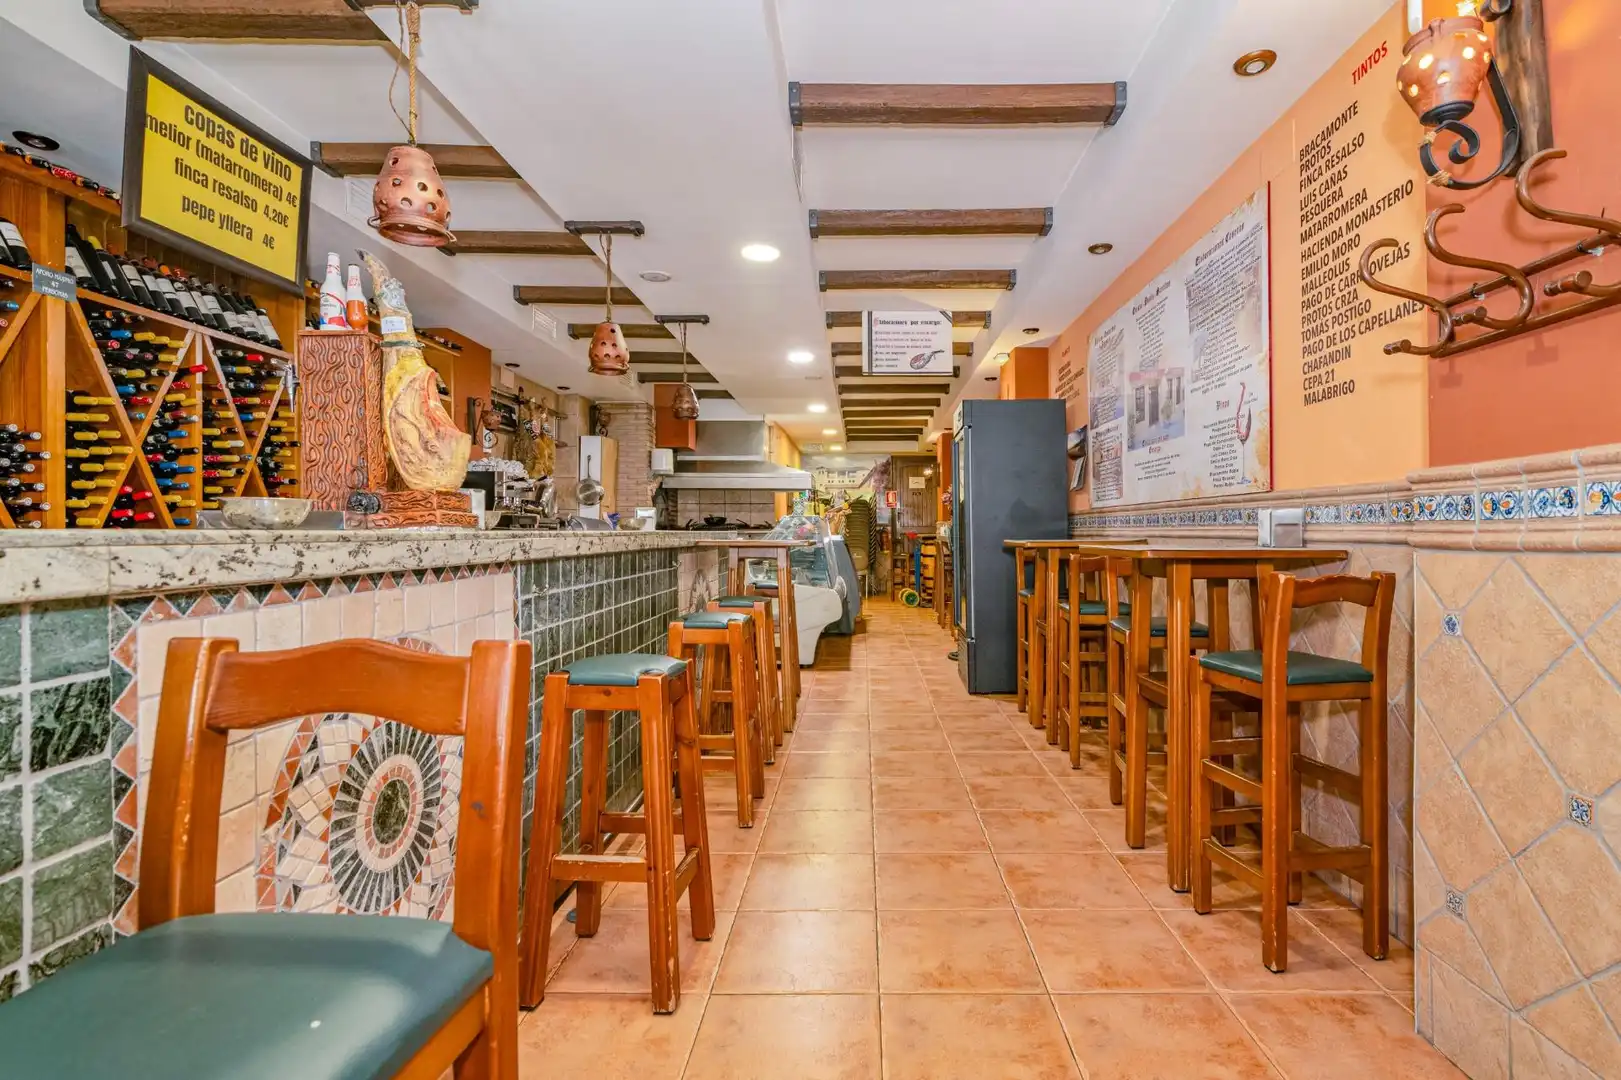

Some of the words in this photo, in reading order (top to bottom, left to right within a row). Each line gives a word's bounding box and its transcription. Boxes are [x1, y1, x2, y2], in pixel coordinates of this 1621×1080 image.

[1351, 40, 1388, 86] TINTOS
[184, 104, 235, 149] copas
[239, 136, 258, 162] de
[262, 149, 292, 182] vino
[1299, 100, 1359, 162] BRACAMONTE
[145, 112, 192, 151] melior
[195, 139, 284, 202] (matarromera)
[286, 191, 298, 208] 4€
[1299, 139, 1332, 177] PROTOS
[1299, 165, 1323, 193] FINCA
[1324, 131, 1365, 173] RESALSO
[174, 157, 209, 189] finca
[212, 177, 258, 213] resalso
[1299, 188, 1317, 212] LUIS
[1319, 164, 1348, 197] CAÑAS
[1300, 185, 1344, 227] PESQUERA
[181, 194, 216, 223] pepe
[218, 211, 253, 242] yllera
[262, 233, 275, 250] 4€
[1300, 187, 1368, 245] MATARROMERA
[1300, 227, 1344, 264] HACIENDA
[1345, 178, 1413, 235] MONASTERIO
[1301, 251, 1329, 281] EMILIO
[1331, 232, 1361, 263] MORO
[1301, 257, 1351, 298] MALLEOLUS
[1301, 291, 1323, 314] PAGO
[1325, 284, 1336, 301] DE
[1338, 241, 1410, 293] CARROVEJAS
[1301, 303, 1333, 329] PROTOS
[1334, 287, 1359, 312] CRZA
[1331, 298, 1372, 330] POSTIGO
[1302, 338, 1324, 359] PAGO
[1326, 332, 1337, 349] DE
[1339, 324, 1356, 344] LOS
[1302, 344, 1351, 375] CHAFANDIN
[1303, 373, 1323, 391] CEPA
[1324, 368, 1335, 384] 21
[1304, 379, 1355, 407] MALABRIGO
